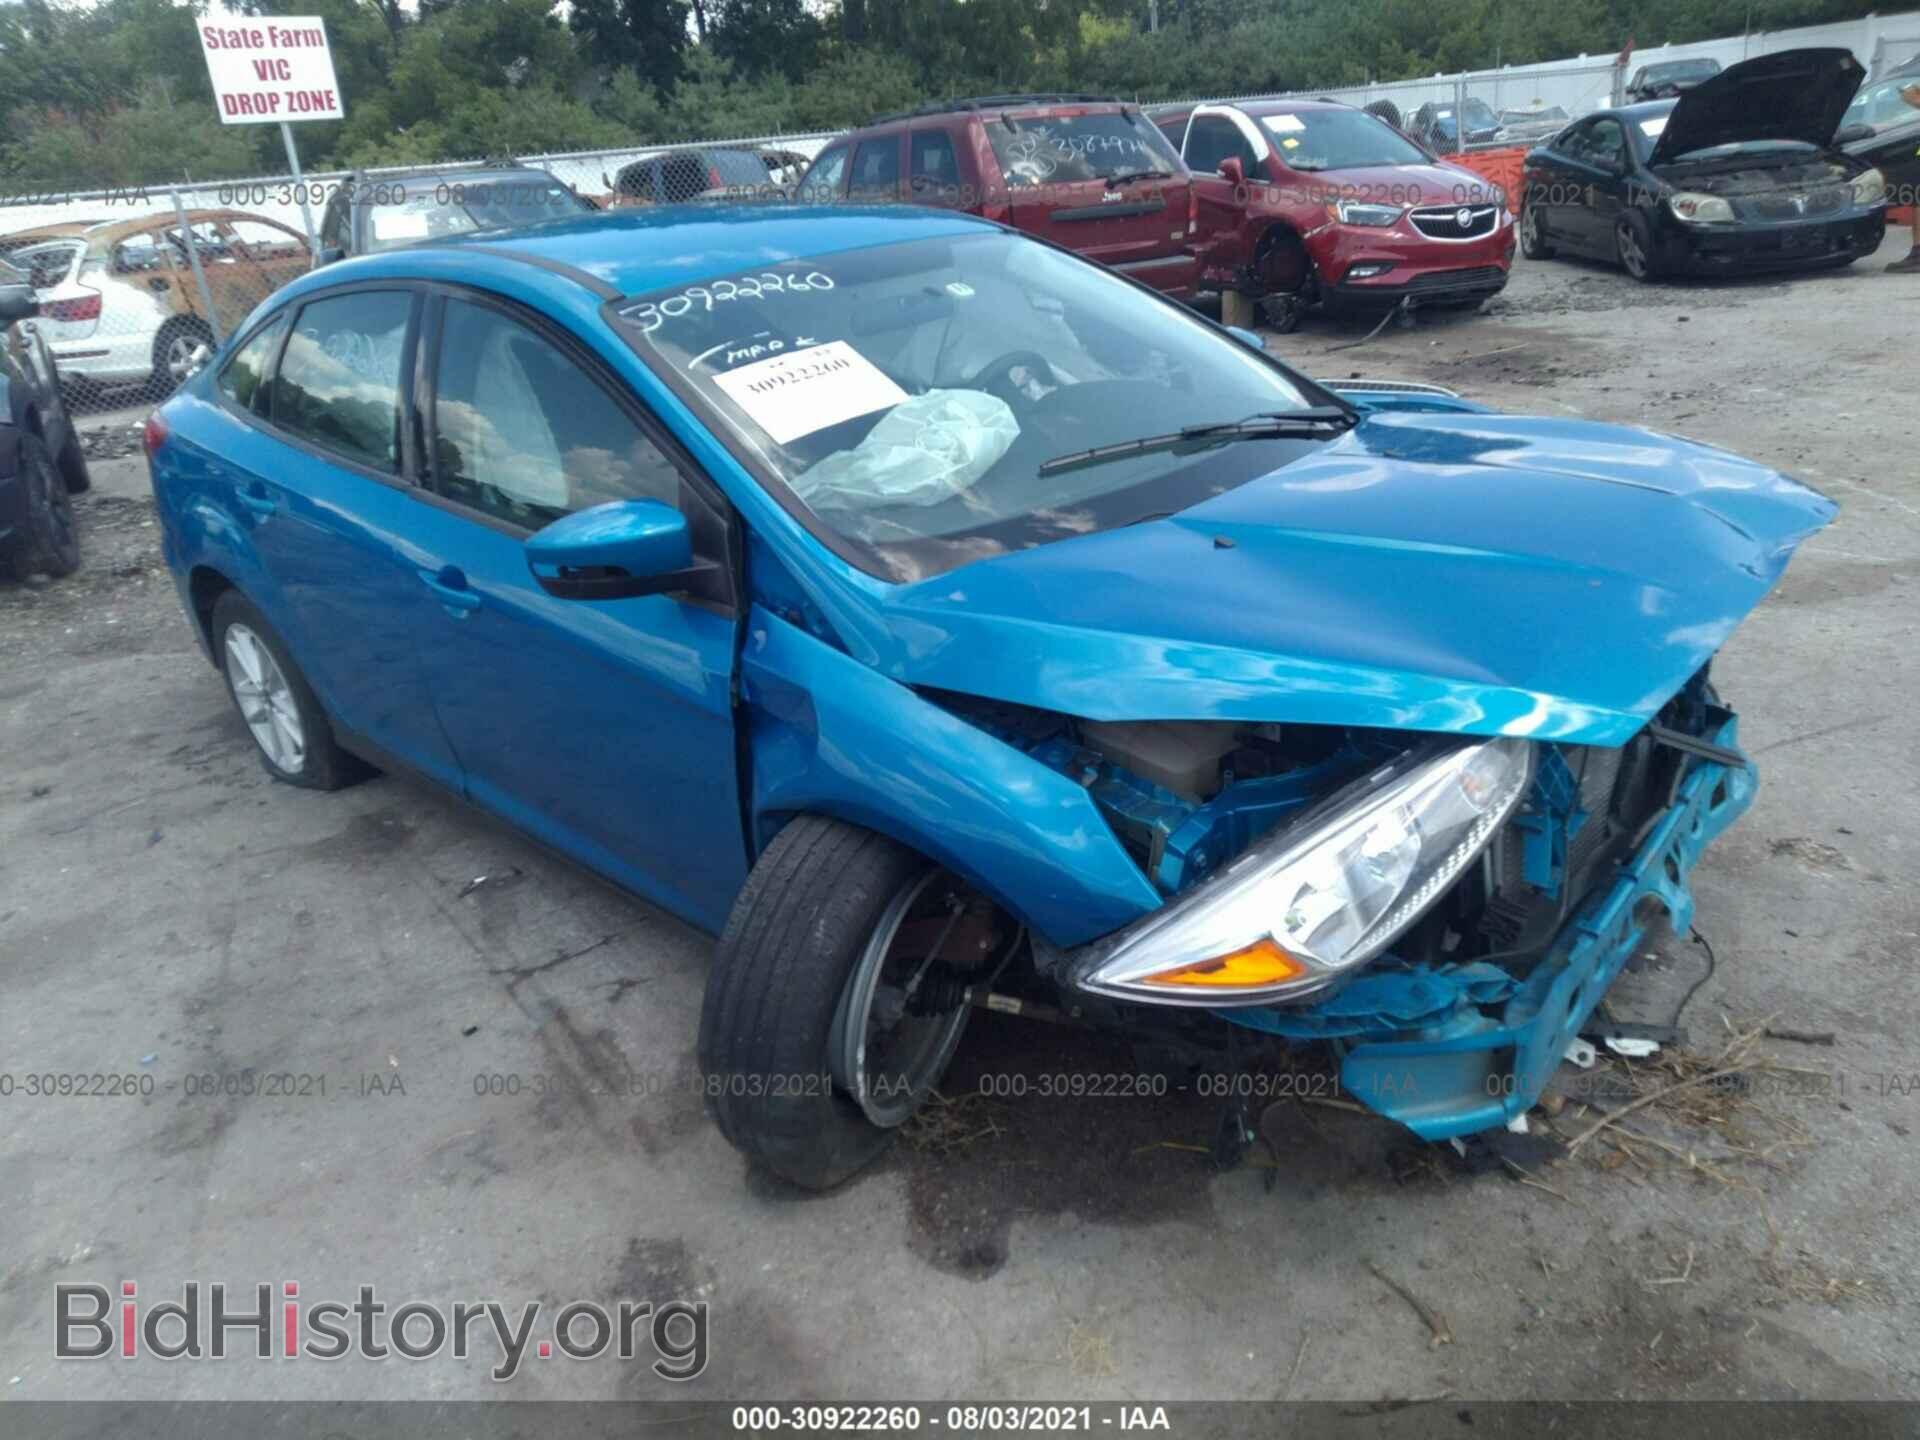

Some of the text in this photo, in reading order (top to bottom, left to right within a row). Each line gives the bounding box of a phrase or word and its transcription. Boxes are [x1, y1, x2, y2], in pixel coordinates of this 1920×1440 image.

[203, 26, 324, 50] State Farm
[252, 58, 292, 81] VIC
[222, 90, 337, 115] DROP ZONE
[618, 271, 836, 333] 30922260
